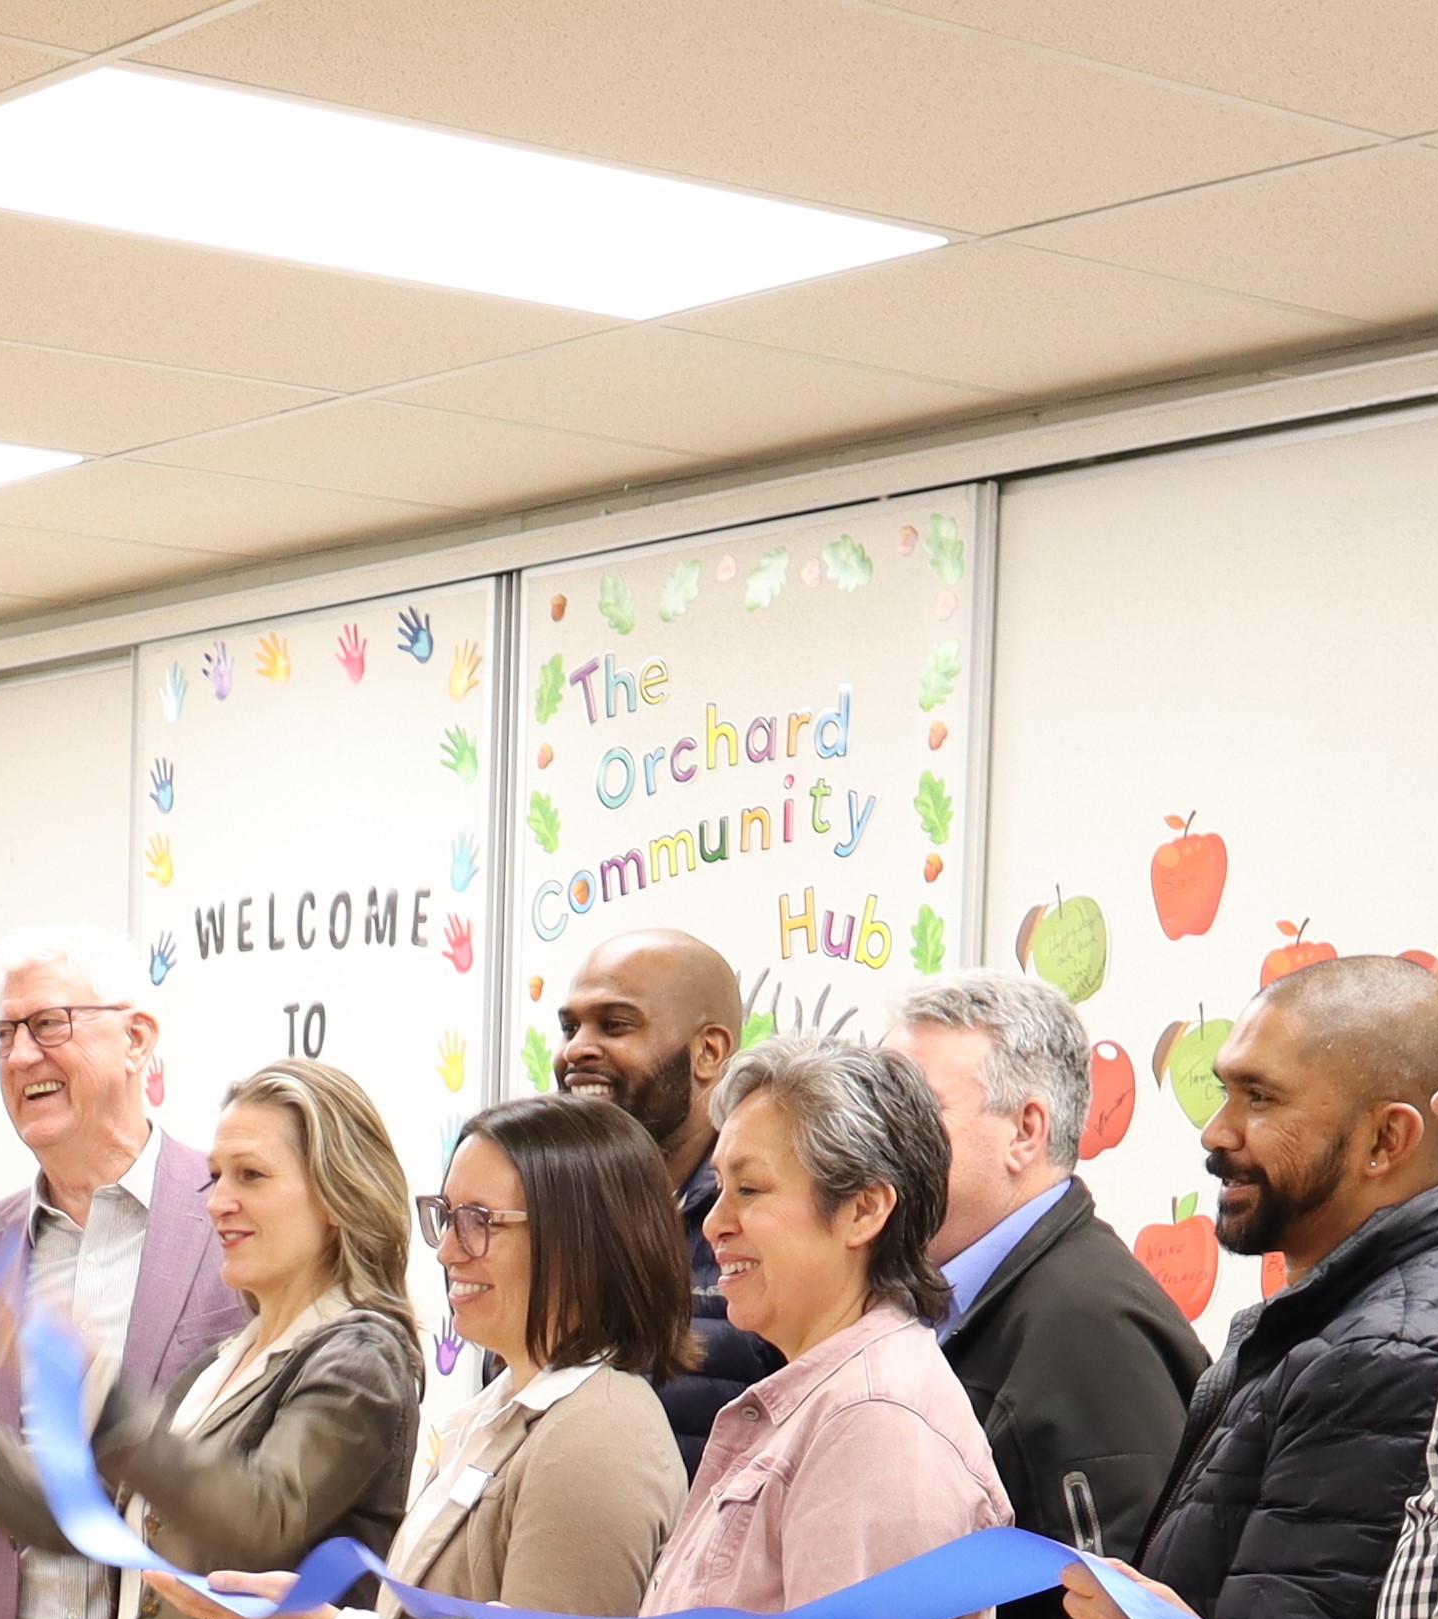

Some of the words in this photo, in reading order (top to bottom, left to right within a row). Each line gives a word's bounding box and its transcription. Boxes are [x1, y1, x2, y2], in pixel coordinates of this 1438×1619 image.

[568, 652, 670, 726] The
[596, 684, 853, 810] Orchard
[531, 773, 878, 942] Community
[195, 884, 432, 961] WELCOME
[778, 886, 893, 969] Hub
[283, 1001, 326, 1060] TO
